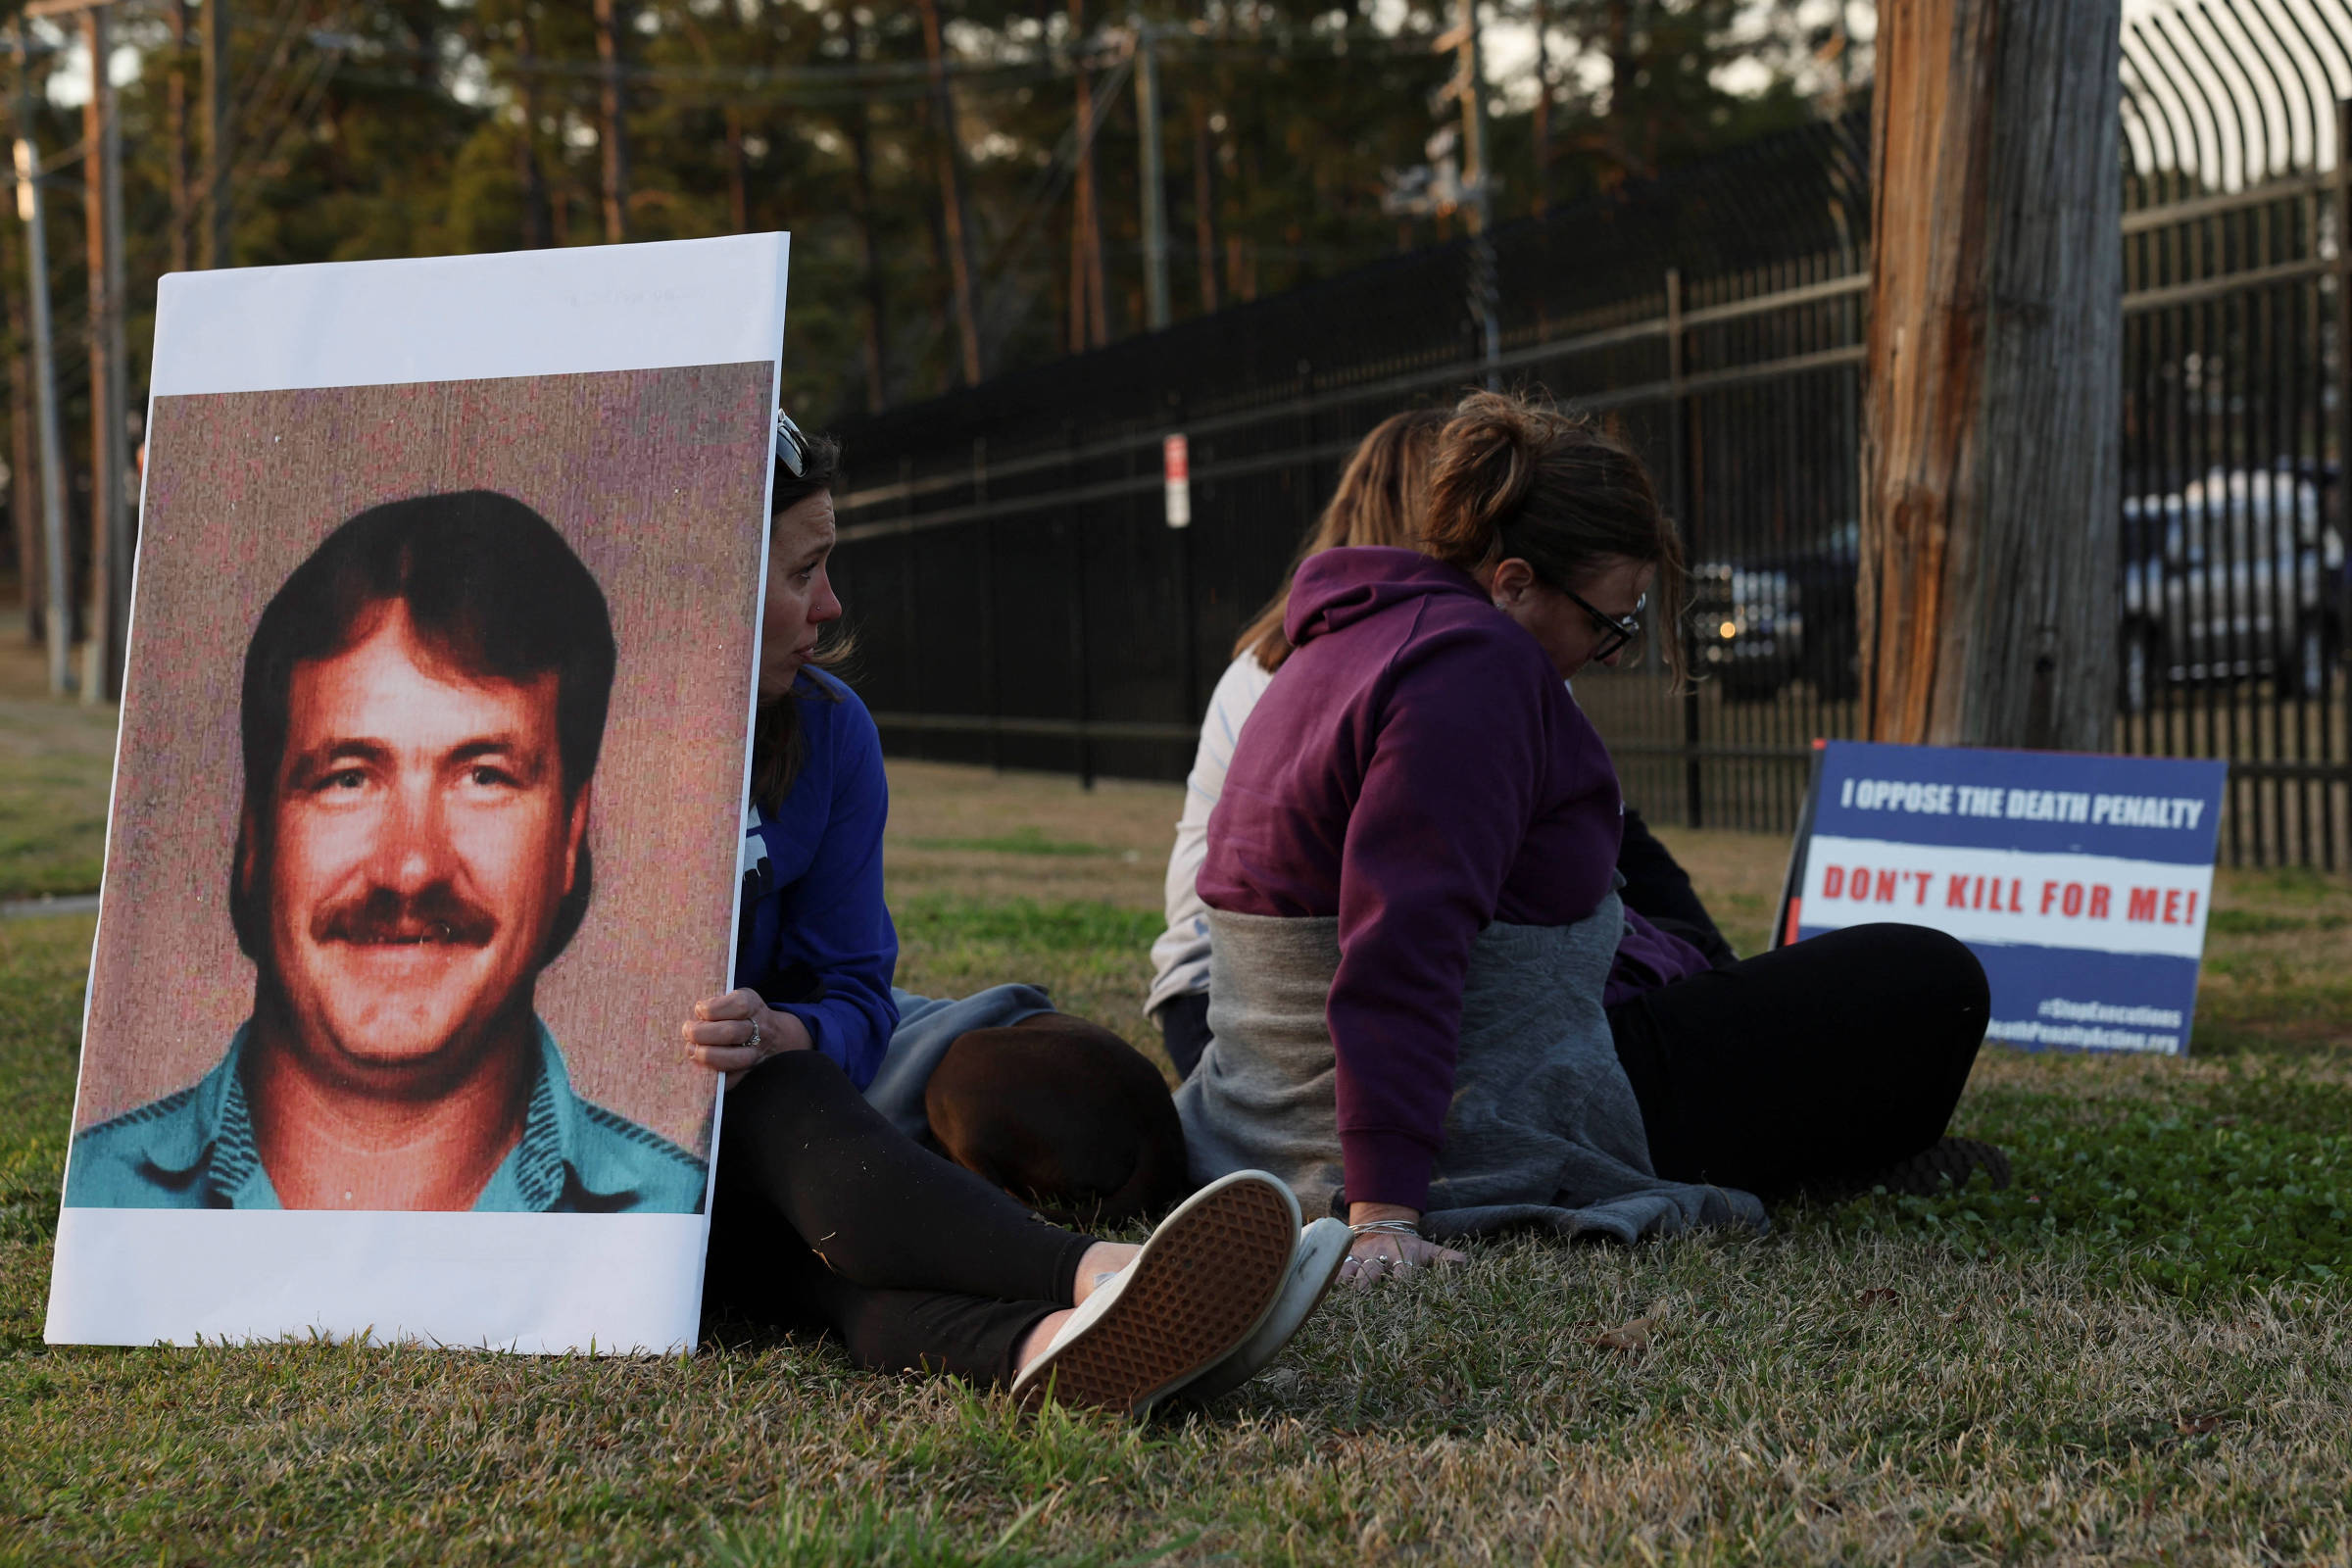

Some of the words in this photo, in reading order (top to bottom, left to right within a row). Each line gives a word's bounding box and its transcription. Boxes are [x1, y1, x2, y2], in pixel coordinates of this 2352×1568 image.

[1841, 779, 1854, 808] I
[1855, 779, 1953, 814] OPPOSE
[1957, 786, 2004, 817] THE
[2006, 789, 2090, 822] DEATH
[2091, 794, 2204, 830] PENALTY
[1822, 864, 1933, 906] DON'T
[1945, 874, 2023, 913] KILL
[2040, 880, 2112, 919] FOR
[2127, 886, 2199, 925] ME!
